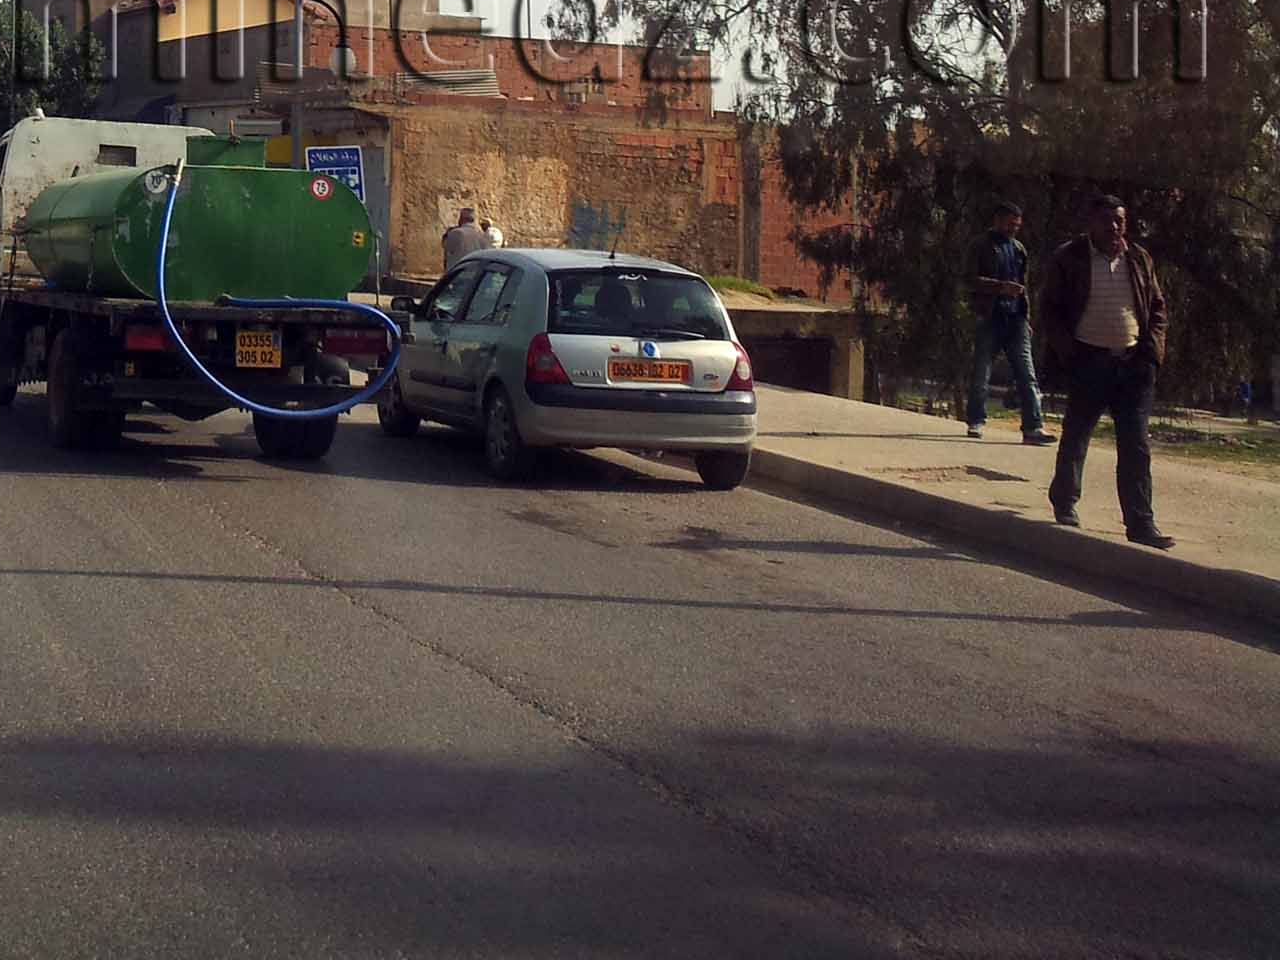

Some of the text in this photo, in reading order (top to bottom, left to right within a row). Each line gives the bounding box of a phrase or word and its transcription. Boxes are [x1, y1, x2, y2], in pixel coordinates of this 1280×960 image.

[316, 182, 327, 195] 75
[238, 350, 273, 363] 305 02
